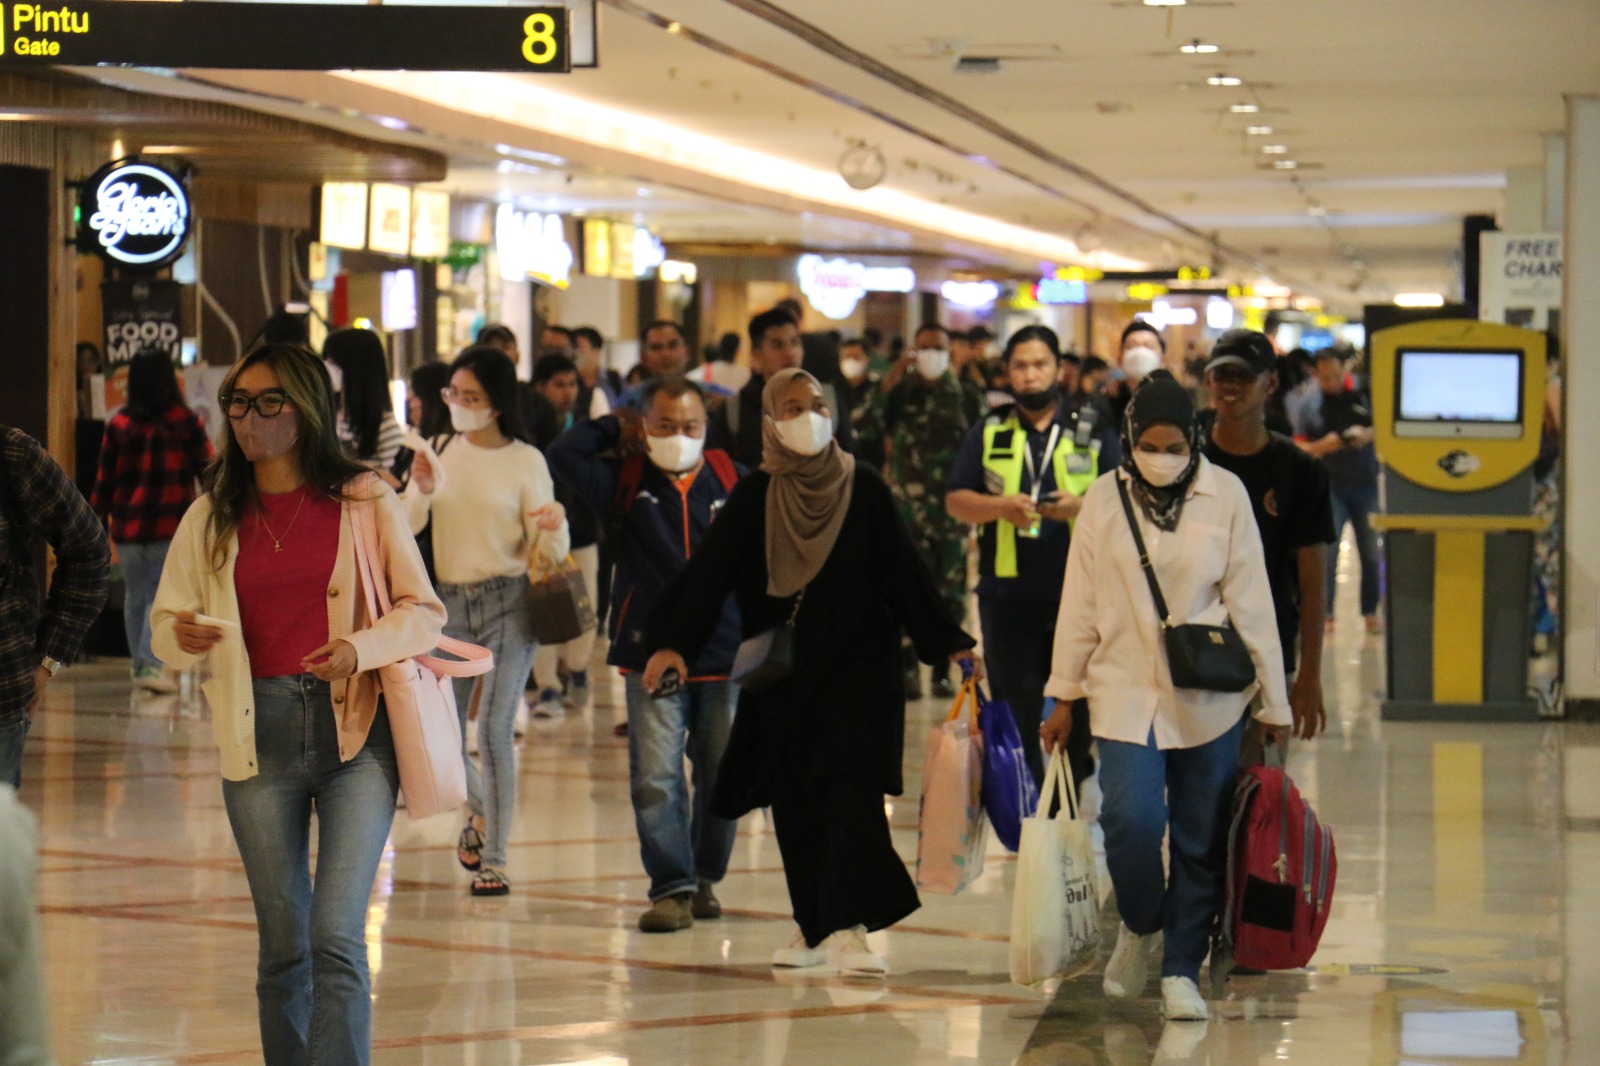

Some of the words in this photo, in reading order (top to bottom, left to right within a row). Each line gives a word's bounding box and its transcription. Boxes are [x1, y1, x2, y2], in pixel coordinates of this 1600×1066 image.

[13, 4, 89, 33] Pintu
[14, 36, 61, 56] Gate
[522, 13, 557, 65] 8
[90, 182, 178, 226] Gloria
[1504, 239, 1560, 257] FREE
[107, 321, 178, 343] FOOD
[107, 340, 180, 363] MEU
